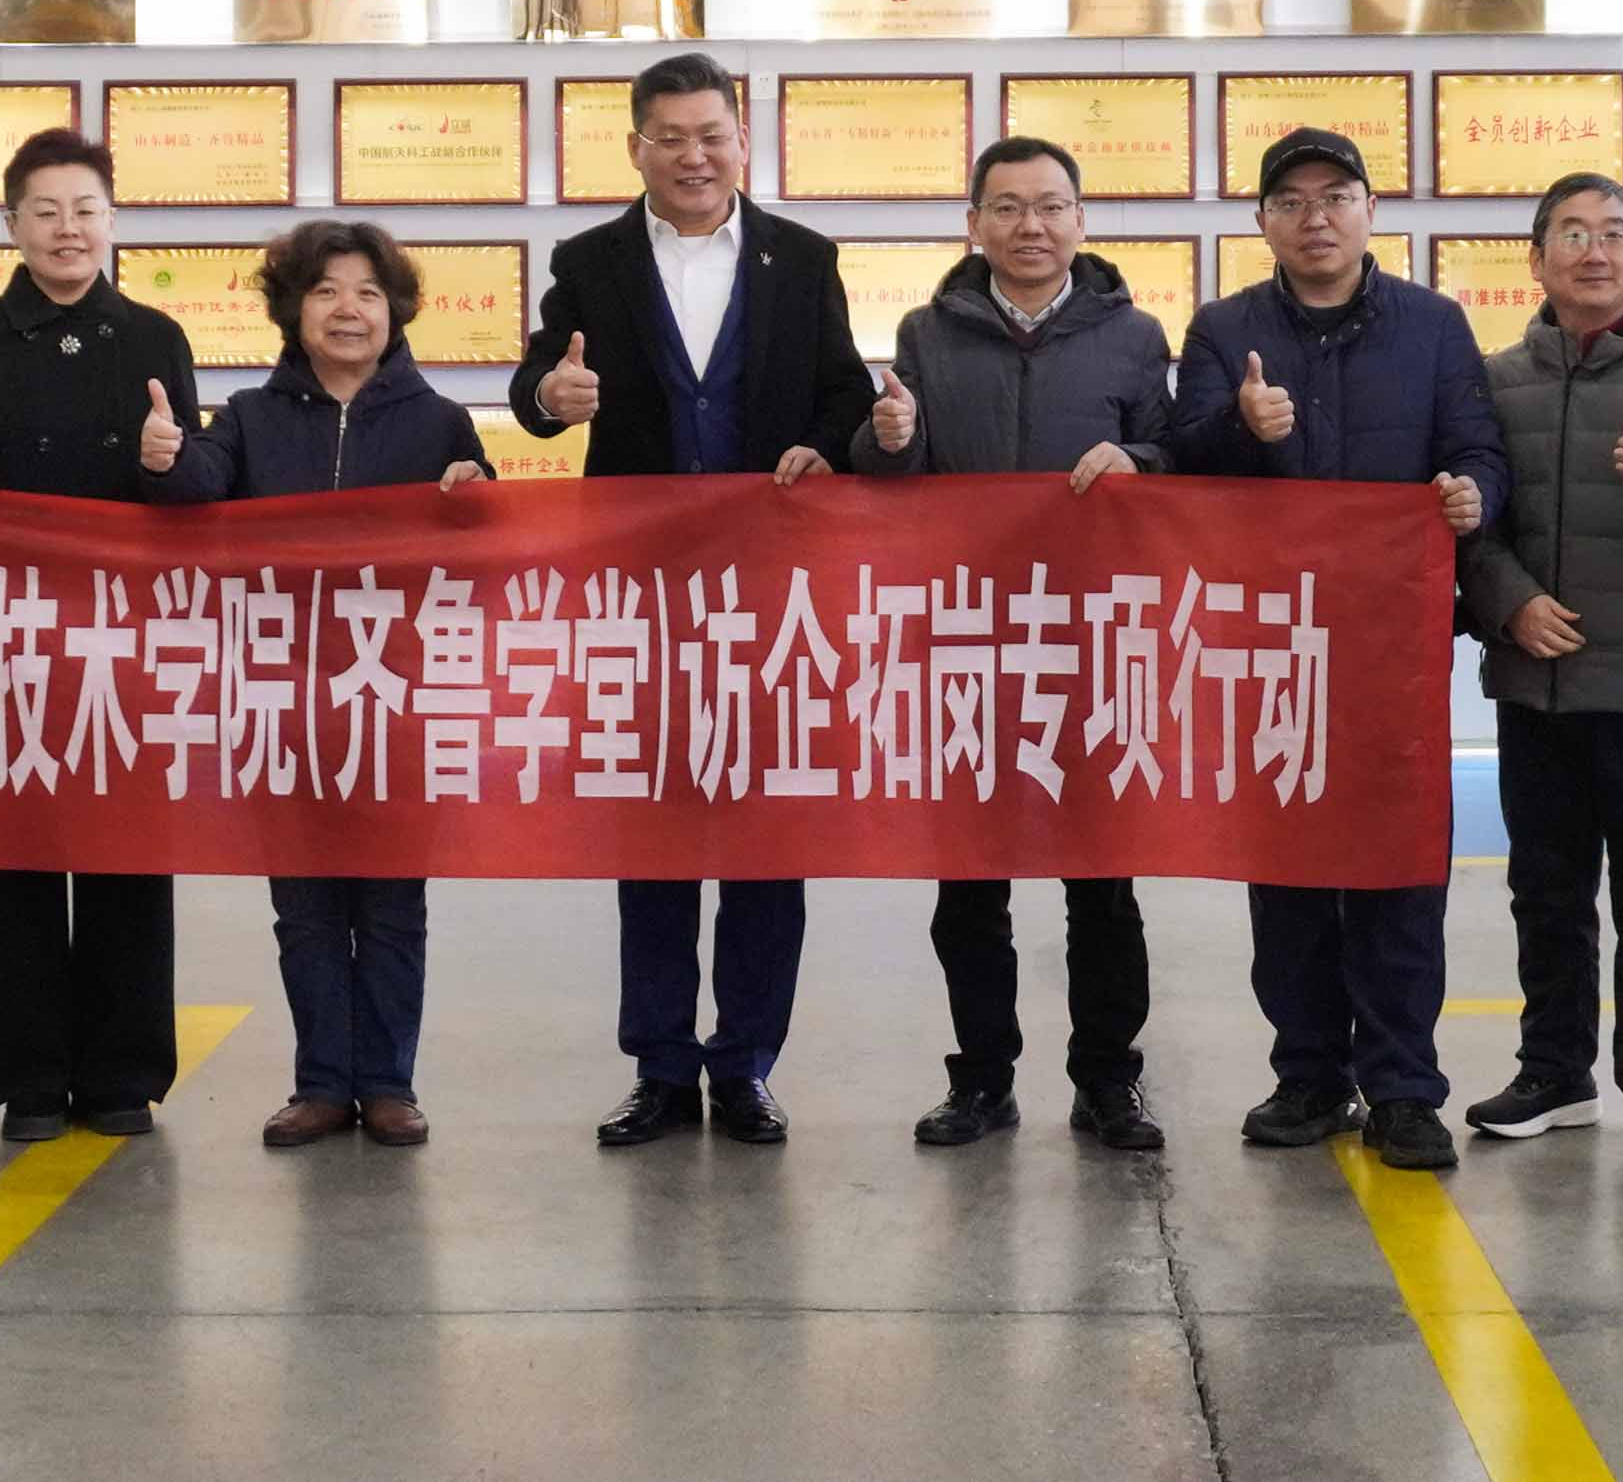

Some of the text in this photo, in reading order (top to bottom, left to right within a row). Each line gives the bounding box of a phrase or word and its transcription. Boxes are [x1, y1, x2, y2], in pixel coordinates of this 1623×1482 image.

[1464, 115, 1599, 145] 全员创新企业
[488, 457, 571, 474] 标杆企业
